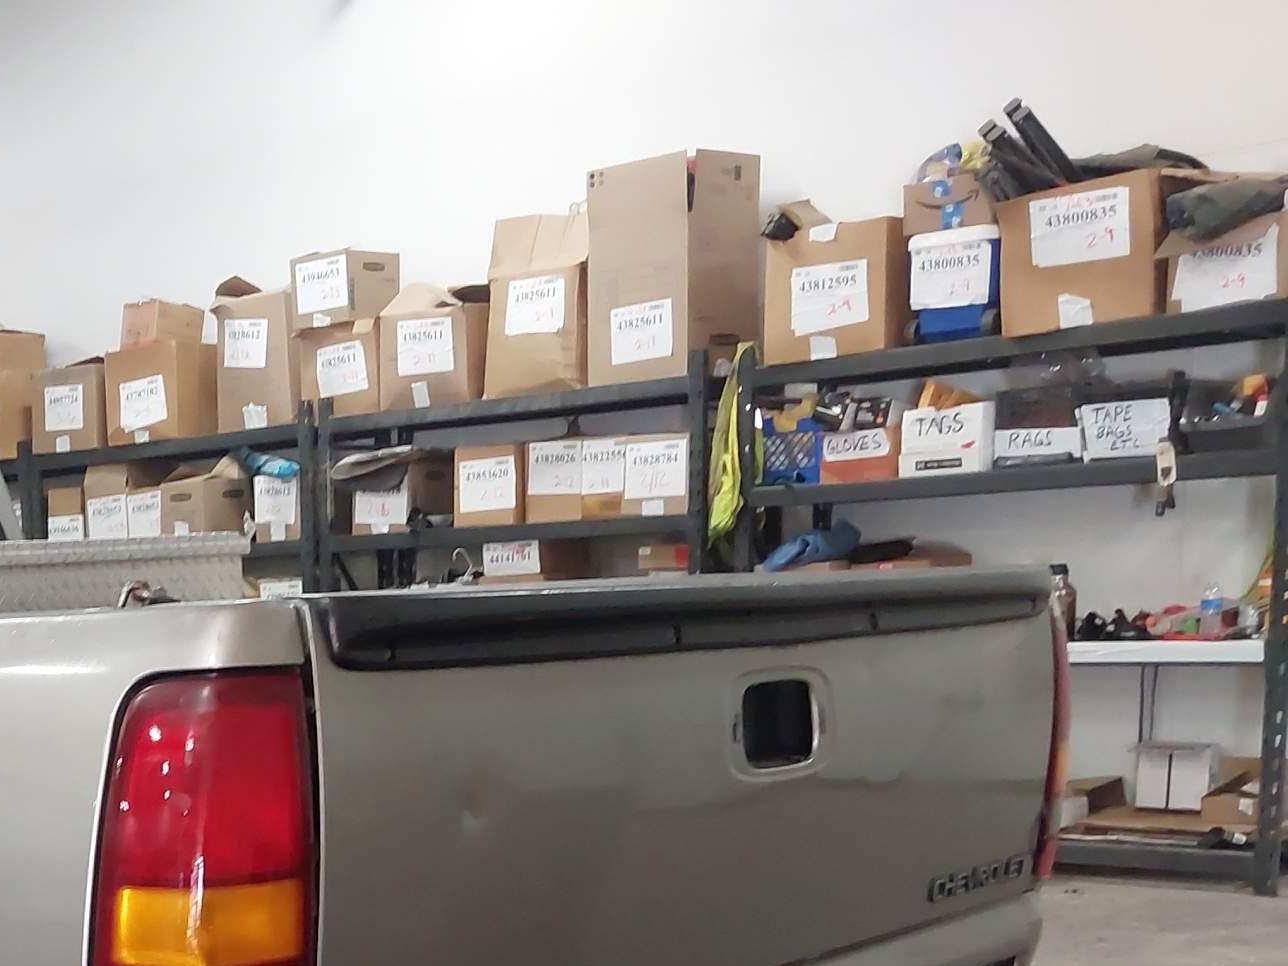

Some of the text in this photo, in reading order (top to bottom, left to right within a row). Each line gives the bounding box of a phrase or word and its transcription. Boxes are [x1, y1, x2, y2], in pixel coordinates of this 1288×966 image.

[1045, 204, 1117, 228] 43800835
[919, 254, 980, 273] 43800835
[799, 274, 858, 293] 43812595
[916, 412, 965, 437] TAGS
[1092, 403, 1133, 425] TAPE
[1007, 429, 1053, 451] RAGS
[1096, 424, 1133, 440] BAGS
[826, 432, 882, 455] GLOVES
